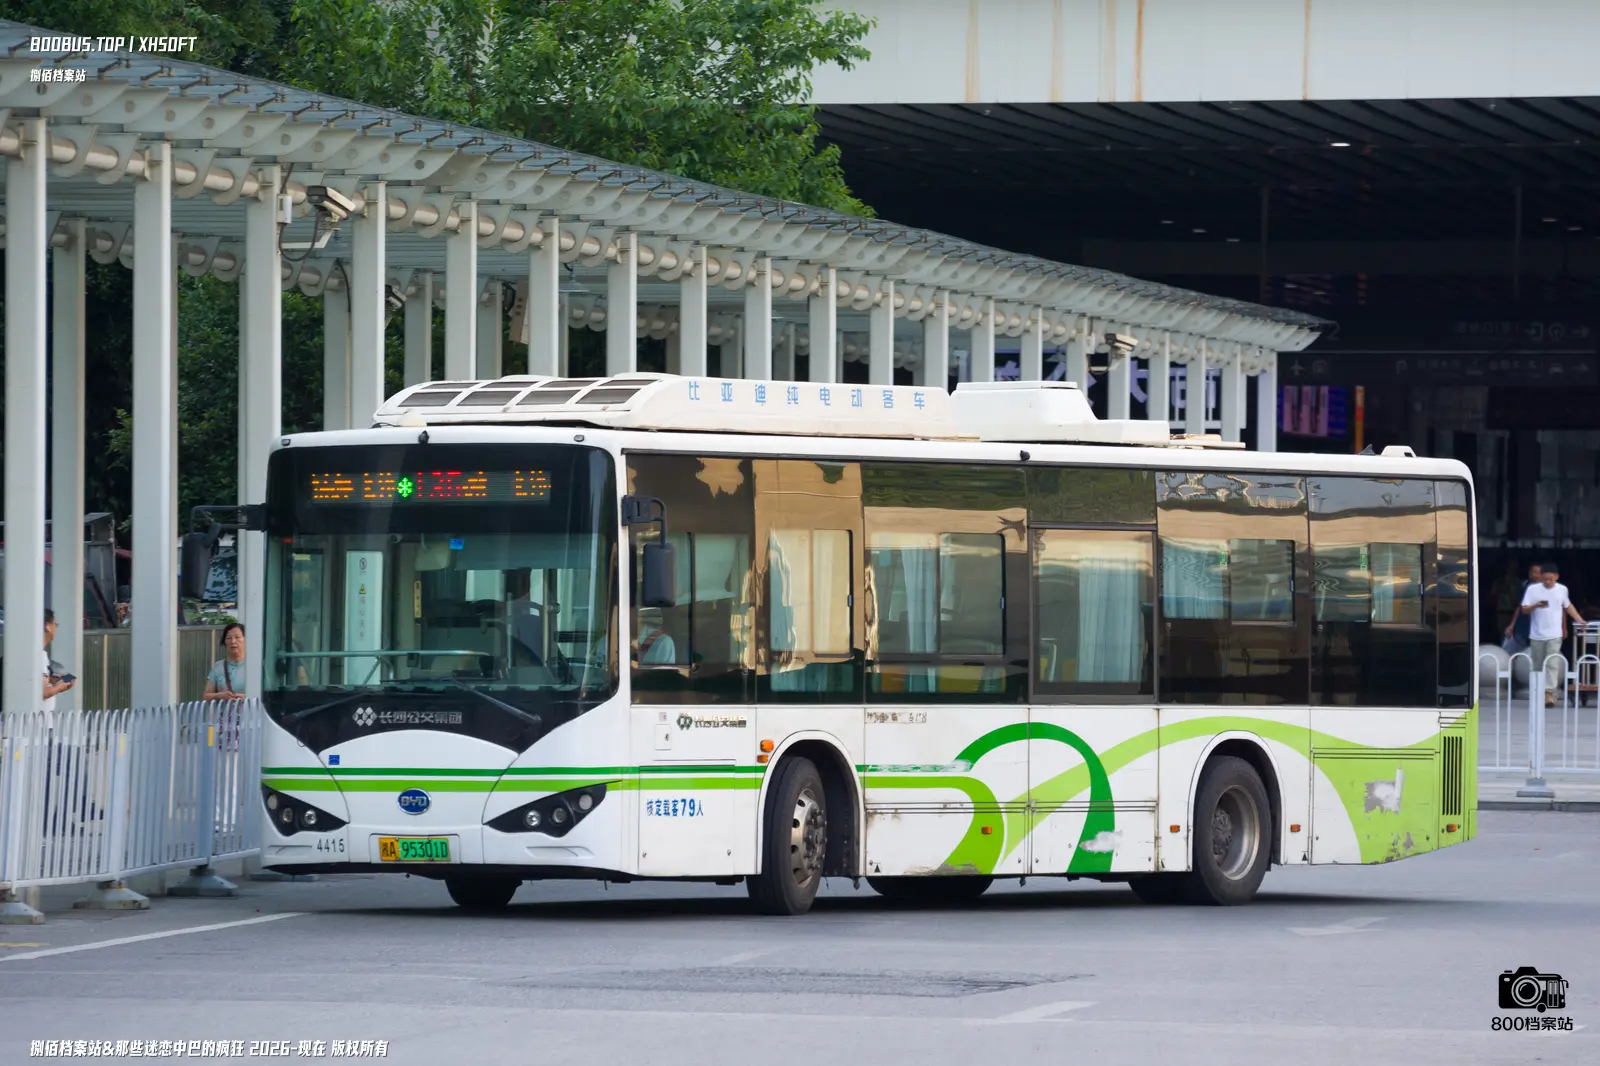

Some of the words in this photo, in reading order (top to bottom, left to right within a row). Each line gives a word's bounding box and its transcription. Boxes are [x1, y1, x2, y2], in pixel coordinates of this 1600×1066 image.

[688, 381, 925, 410] 比亚迪纯电动客车
[378, 711, 463, 725] 长沙公交集团
[646, 798, 704, 817] 核定载客79人
[317, 838, 345, 853] 4415
